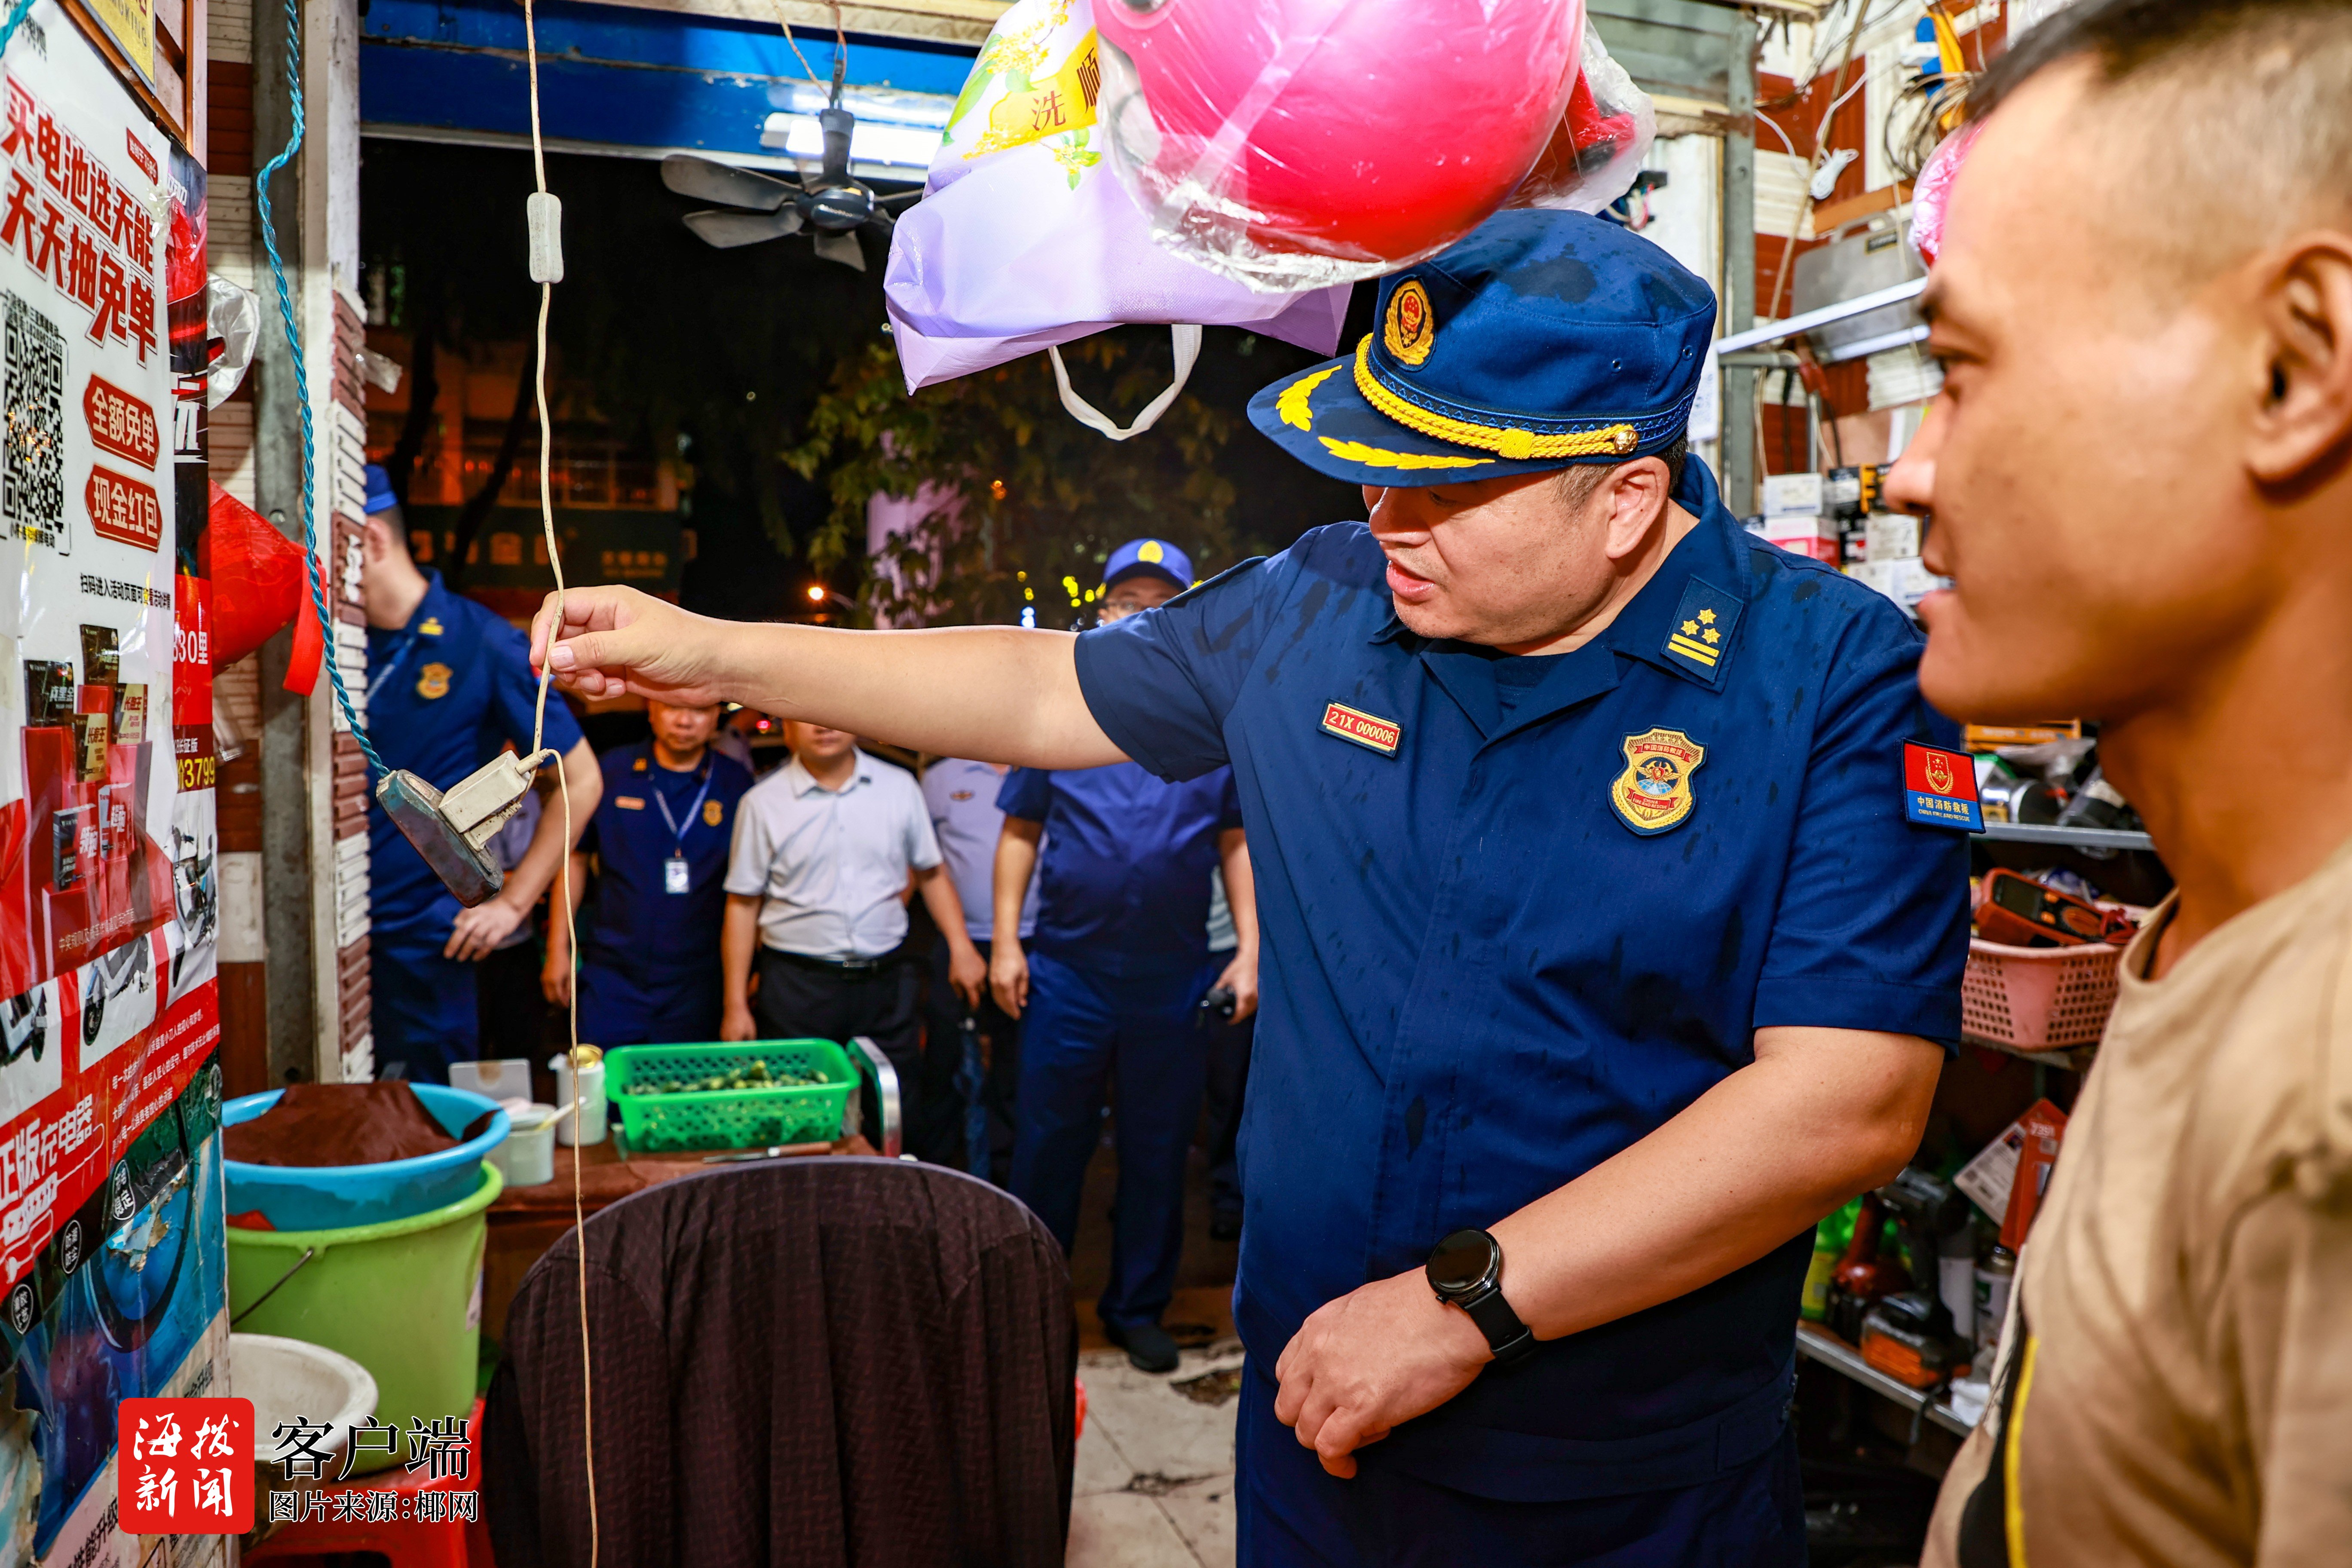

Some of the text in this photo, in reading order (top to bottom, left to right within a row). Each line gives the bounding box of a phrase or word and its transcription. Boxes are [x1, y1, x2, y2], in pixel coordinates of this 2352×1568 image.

[1031, 90, 1066, 132] 洗
[1, 74, 154, 279] 买电池选天能
[1, 169, 157, 364] 天天抽免单
[92, 388, 155, 457] 全额免单
[93, 475, 158, 540] 现金红包
[1329, 711, 1395, 744] 21X 000006
[1644, 744, 1683, 756] 中国消防救援
[1917, 796, 1969, 815] 中国消防救援
[0, 1093, 92, 1210] 正版充电器
